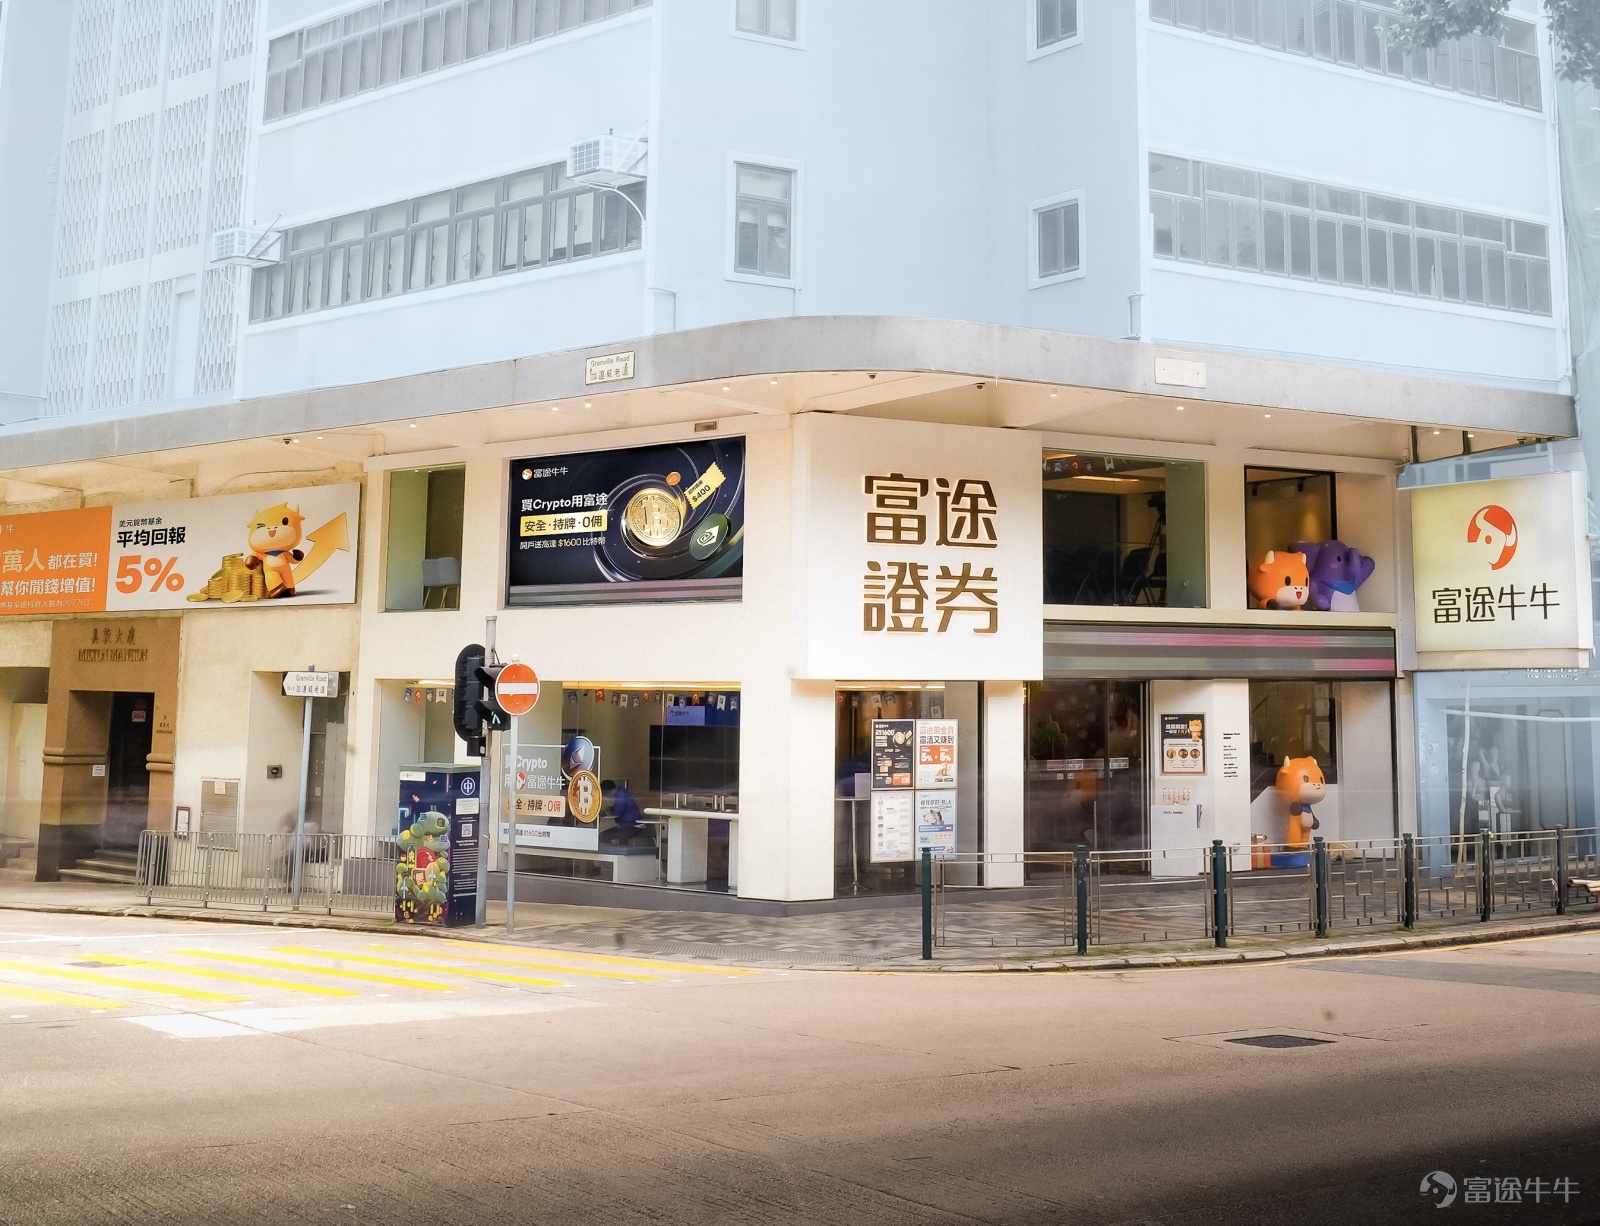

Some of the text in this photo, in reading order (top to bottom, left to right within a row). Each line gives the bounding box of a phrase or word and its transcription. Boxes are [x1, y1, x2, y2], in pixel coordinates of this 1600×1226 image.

[590, 358, 614, 367] Granville
[533, 466, 569, 479] 富途牛牛
[521, 492, 608, 512] 買Crypto用富途
[691, 484, 711, 502] $400
[864, 473, 998, 548] 富途
[119, 517, 163, 528] 美元貨幣基金
[116, 526, 186, 548] 平均回報
[557, 538, 582, 548] $1600
[115, 555, 185, 594] 5%
[863, 560, 998, 633] 證券
[1432, 582, 1560, 624] 富途牛牛
[527, 774, 566, 790] 富途牛牛
[508, 797, 561, 813] 全·持牌·0佣
